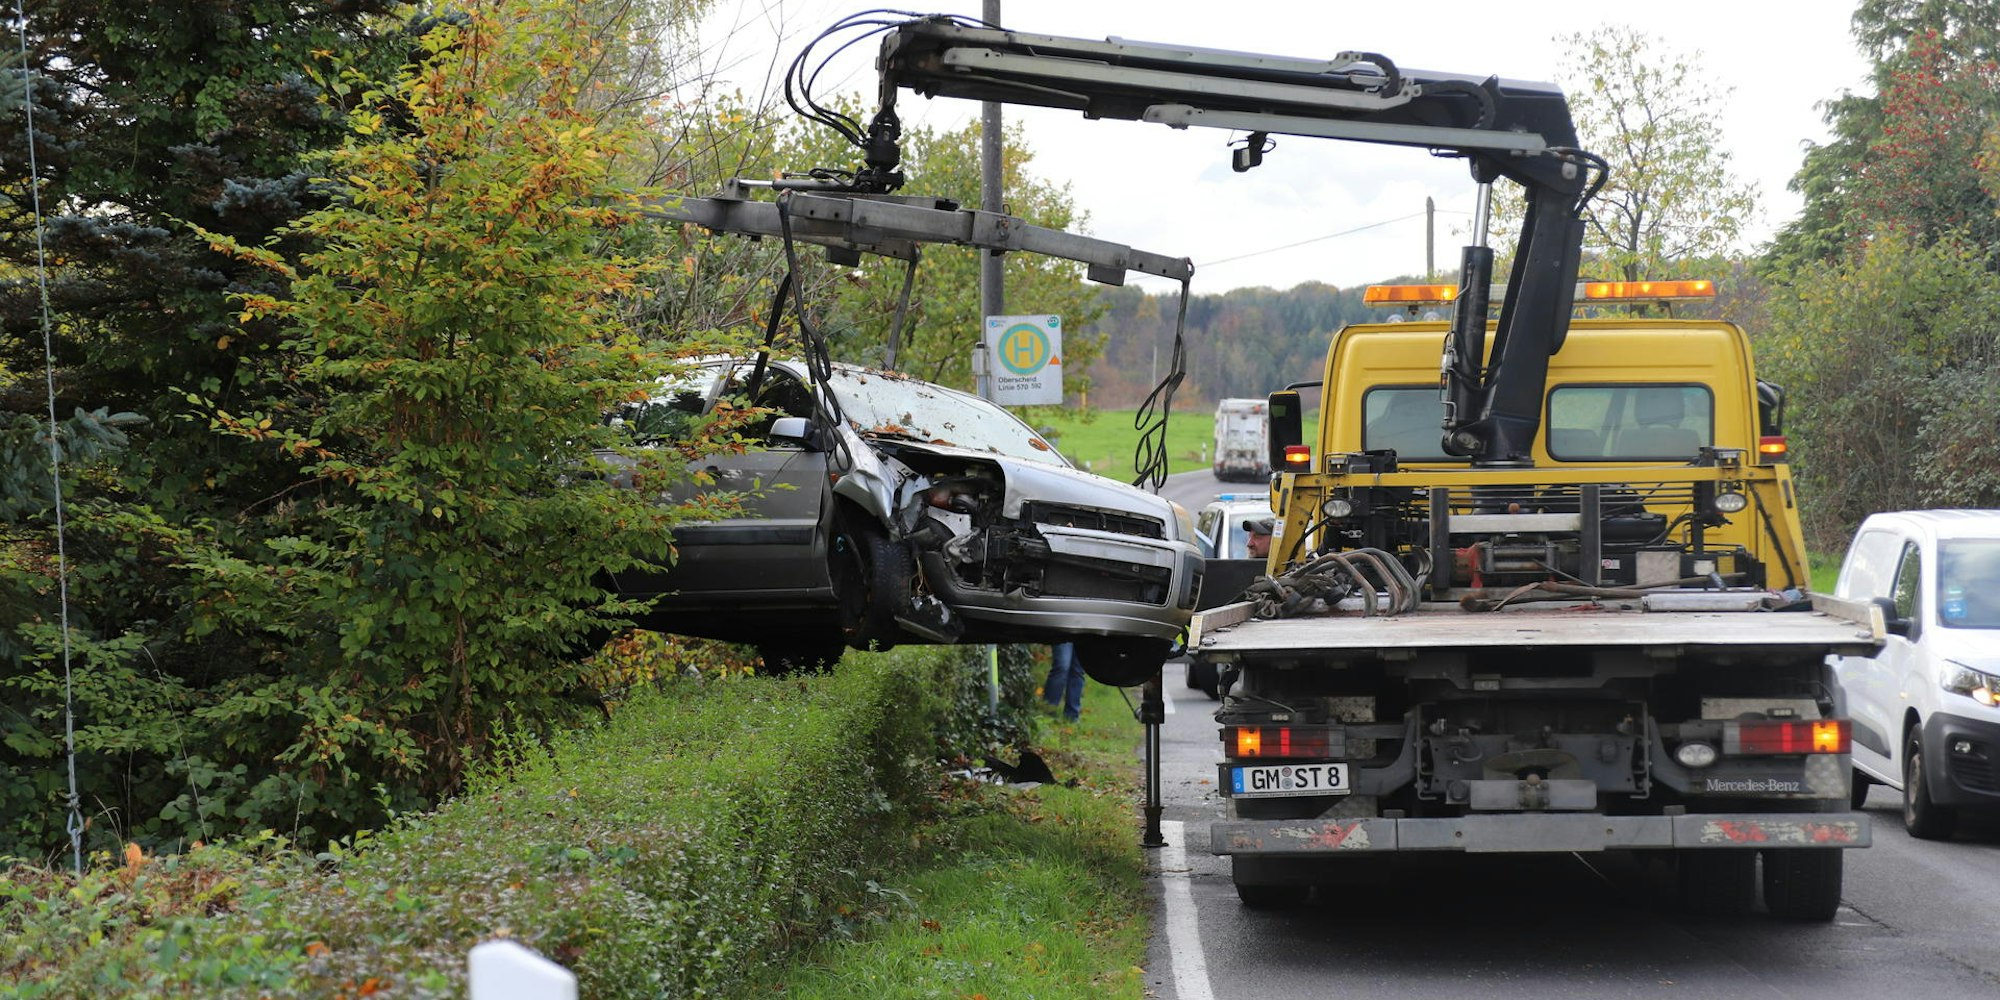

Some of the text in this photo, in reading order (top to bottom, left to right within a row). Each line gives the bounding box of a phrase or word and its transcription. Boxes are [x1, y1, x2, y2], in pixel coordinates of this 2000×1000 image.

[1014, 335, 1034, 363] H
[1252, 768, 1280, 790] GM
[1295, 767, 1321, 788] ST
[1328, 766, 1340, 787] 8
[1706, 778, 1799, 792] Mercedes-Benz
